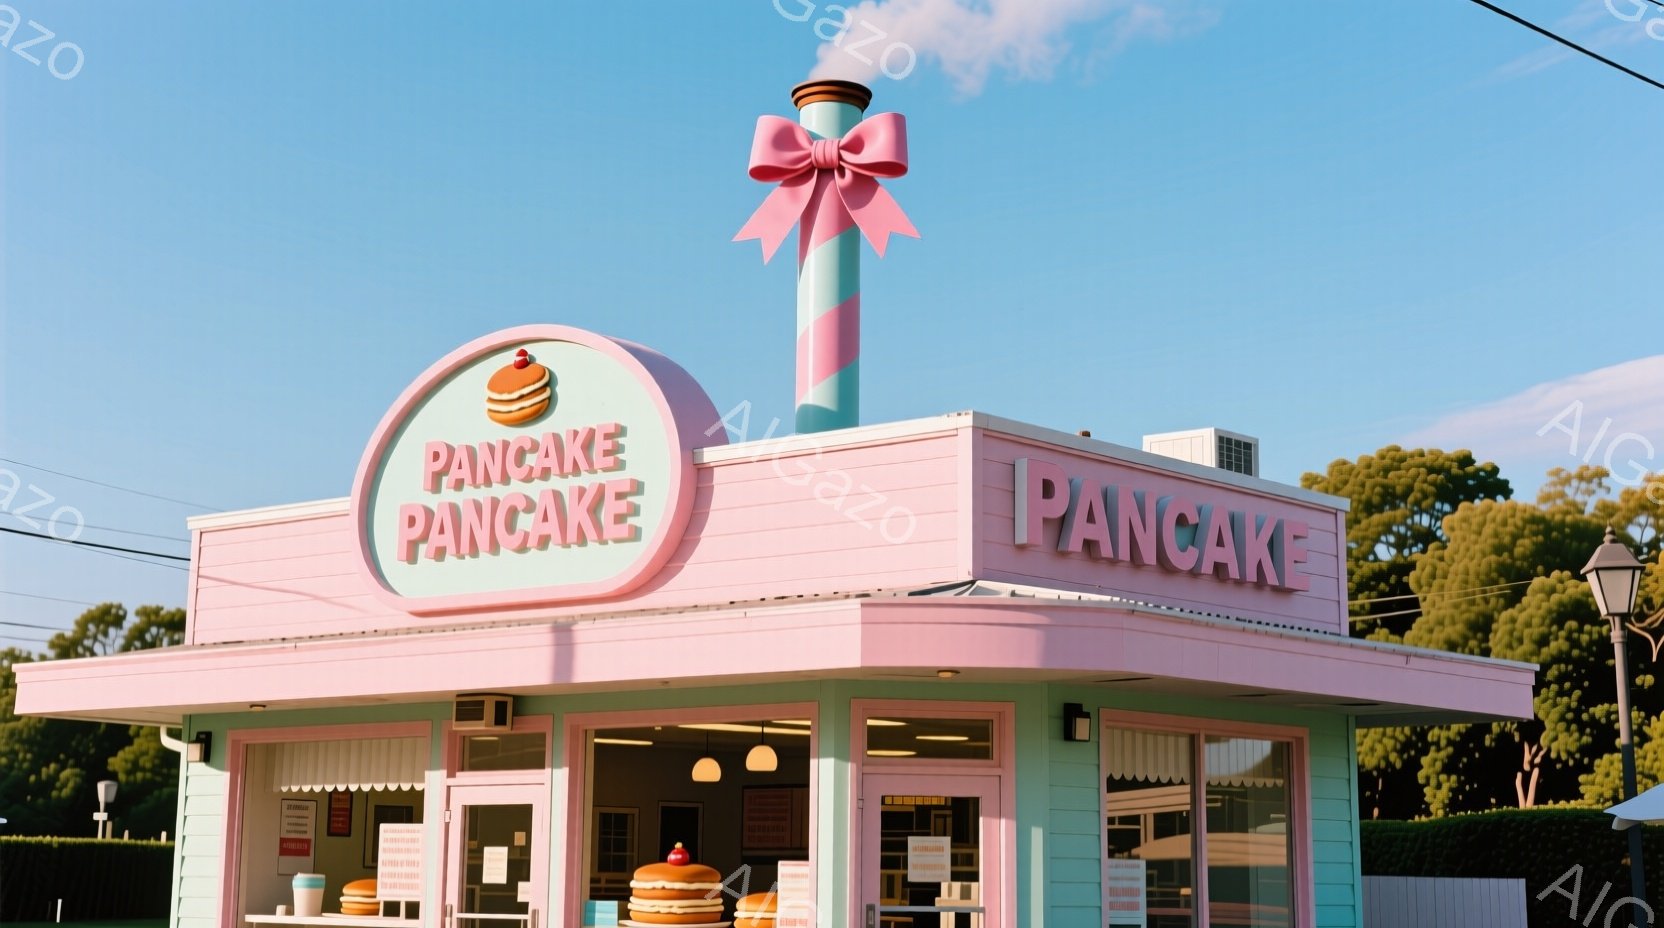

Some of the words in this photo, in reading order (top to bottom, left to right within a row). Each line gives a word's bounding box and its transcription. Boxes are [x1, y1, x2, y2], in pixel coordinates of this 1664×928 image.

[423, 423, 624, 491] PANCAKE
[397, 478, 640, 563] PANCAKE
[1015, 458, 1310, 592] PANCAKE
